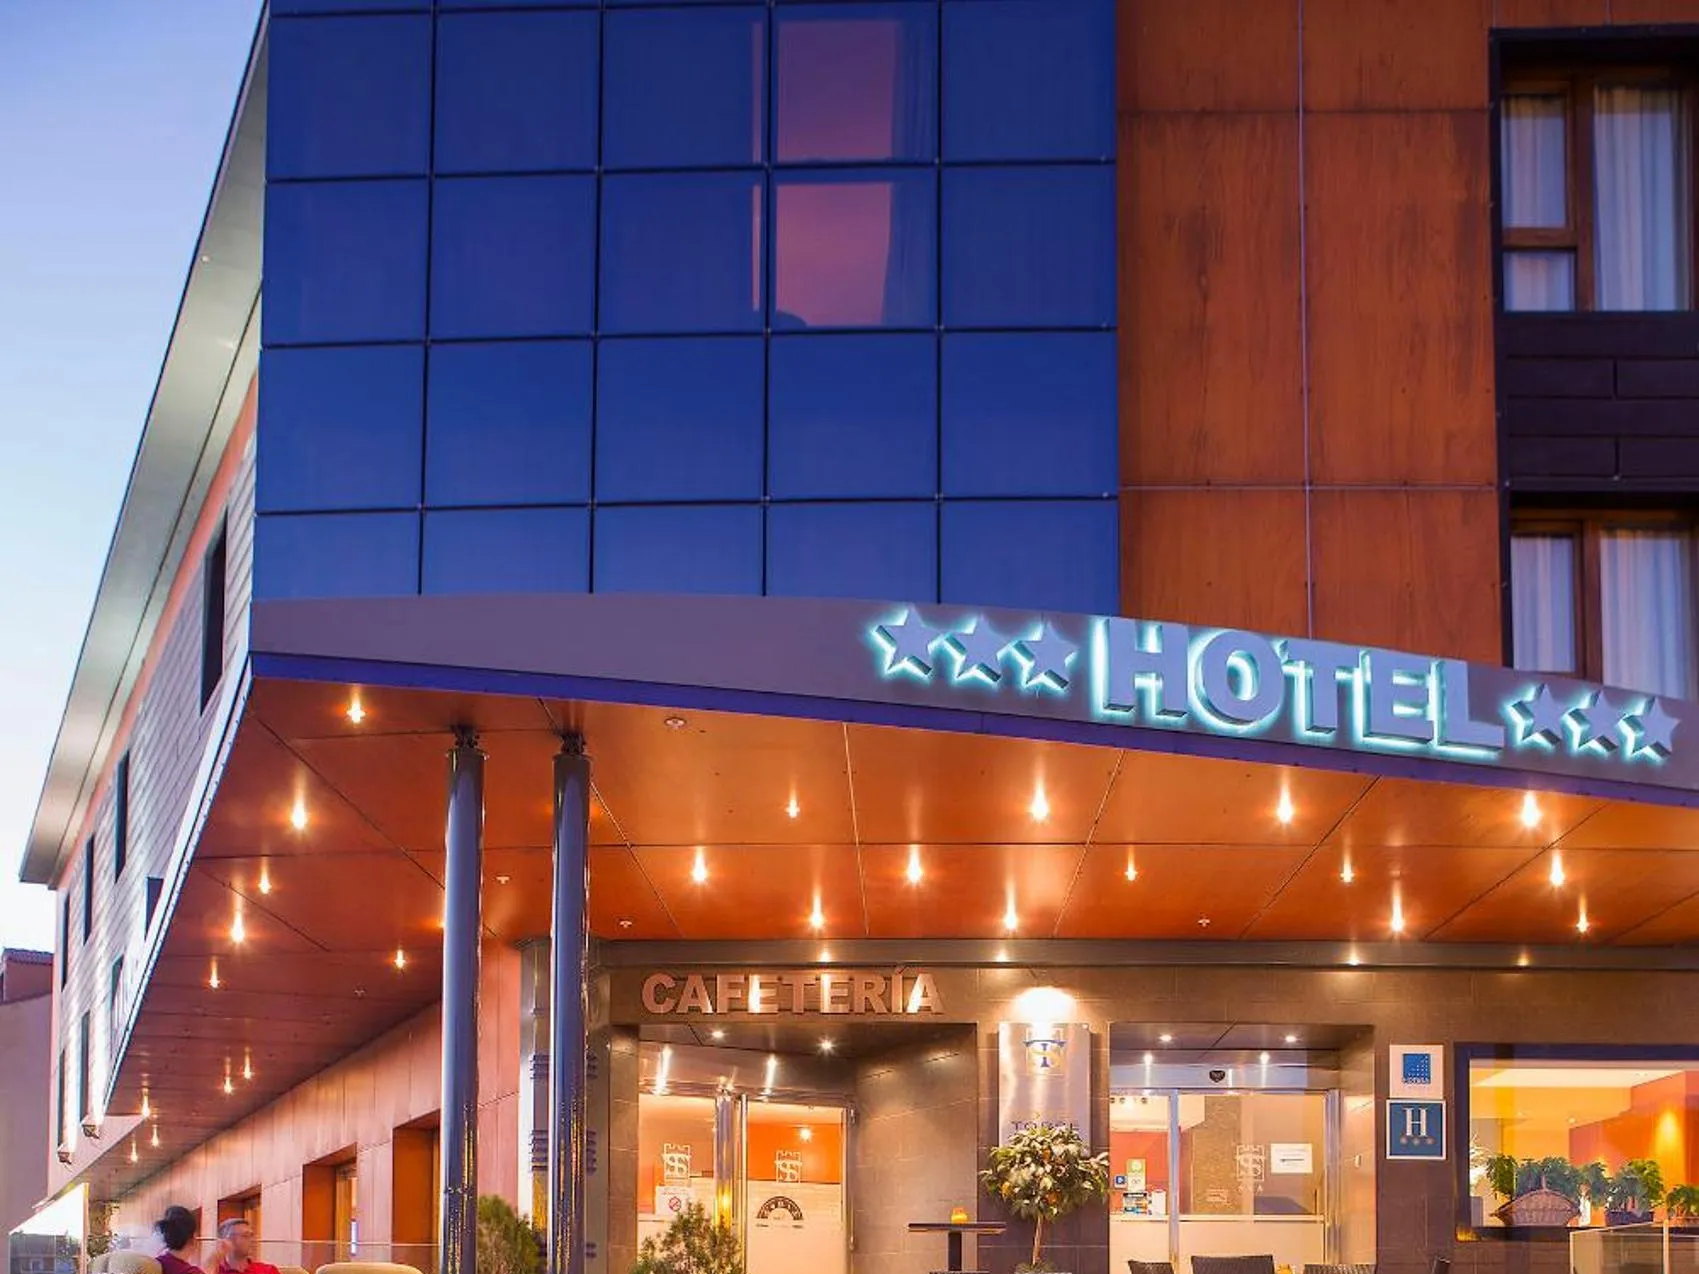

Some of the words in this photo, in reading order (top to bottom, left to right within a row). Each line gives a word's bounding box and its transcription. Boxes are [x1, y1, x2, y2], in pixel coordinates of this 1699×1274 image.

[1088, 615, 1505, 759] HOTEL
[641, 965, 946, 1015] CAFETERÍA
[1402, 1107, 1428, 1138] H
